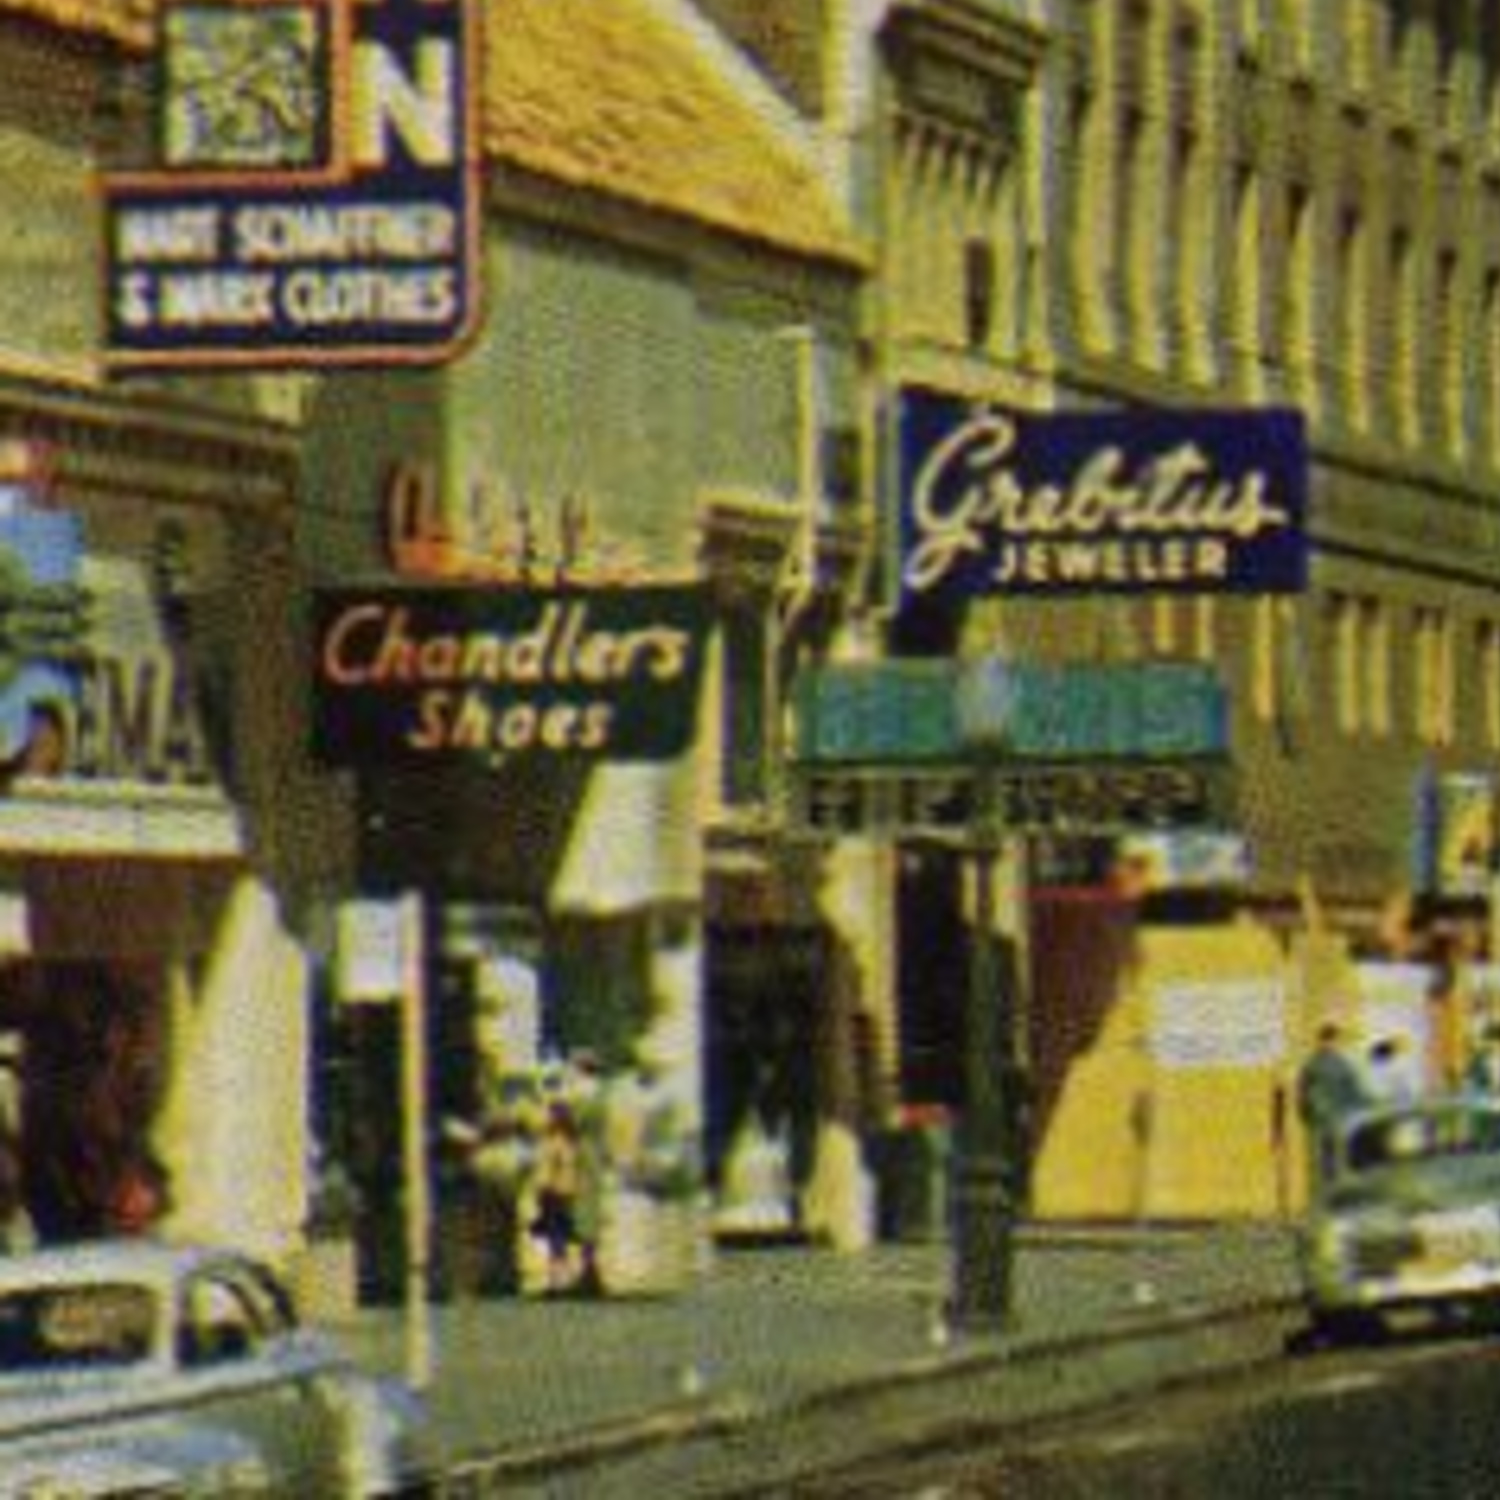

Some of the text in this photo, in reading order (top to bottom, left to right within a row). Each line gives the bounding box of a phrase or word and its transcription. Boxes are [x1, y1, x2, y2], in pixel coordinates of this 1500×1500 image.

[903, 405, 1288, 590] Grebitus
[994, 540, 1227, 582] JEWELER
[408, 690, 614, 750] Shoes
